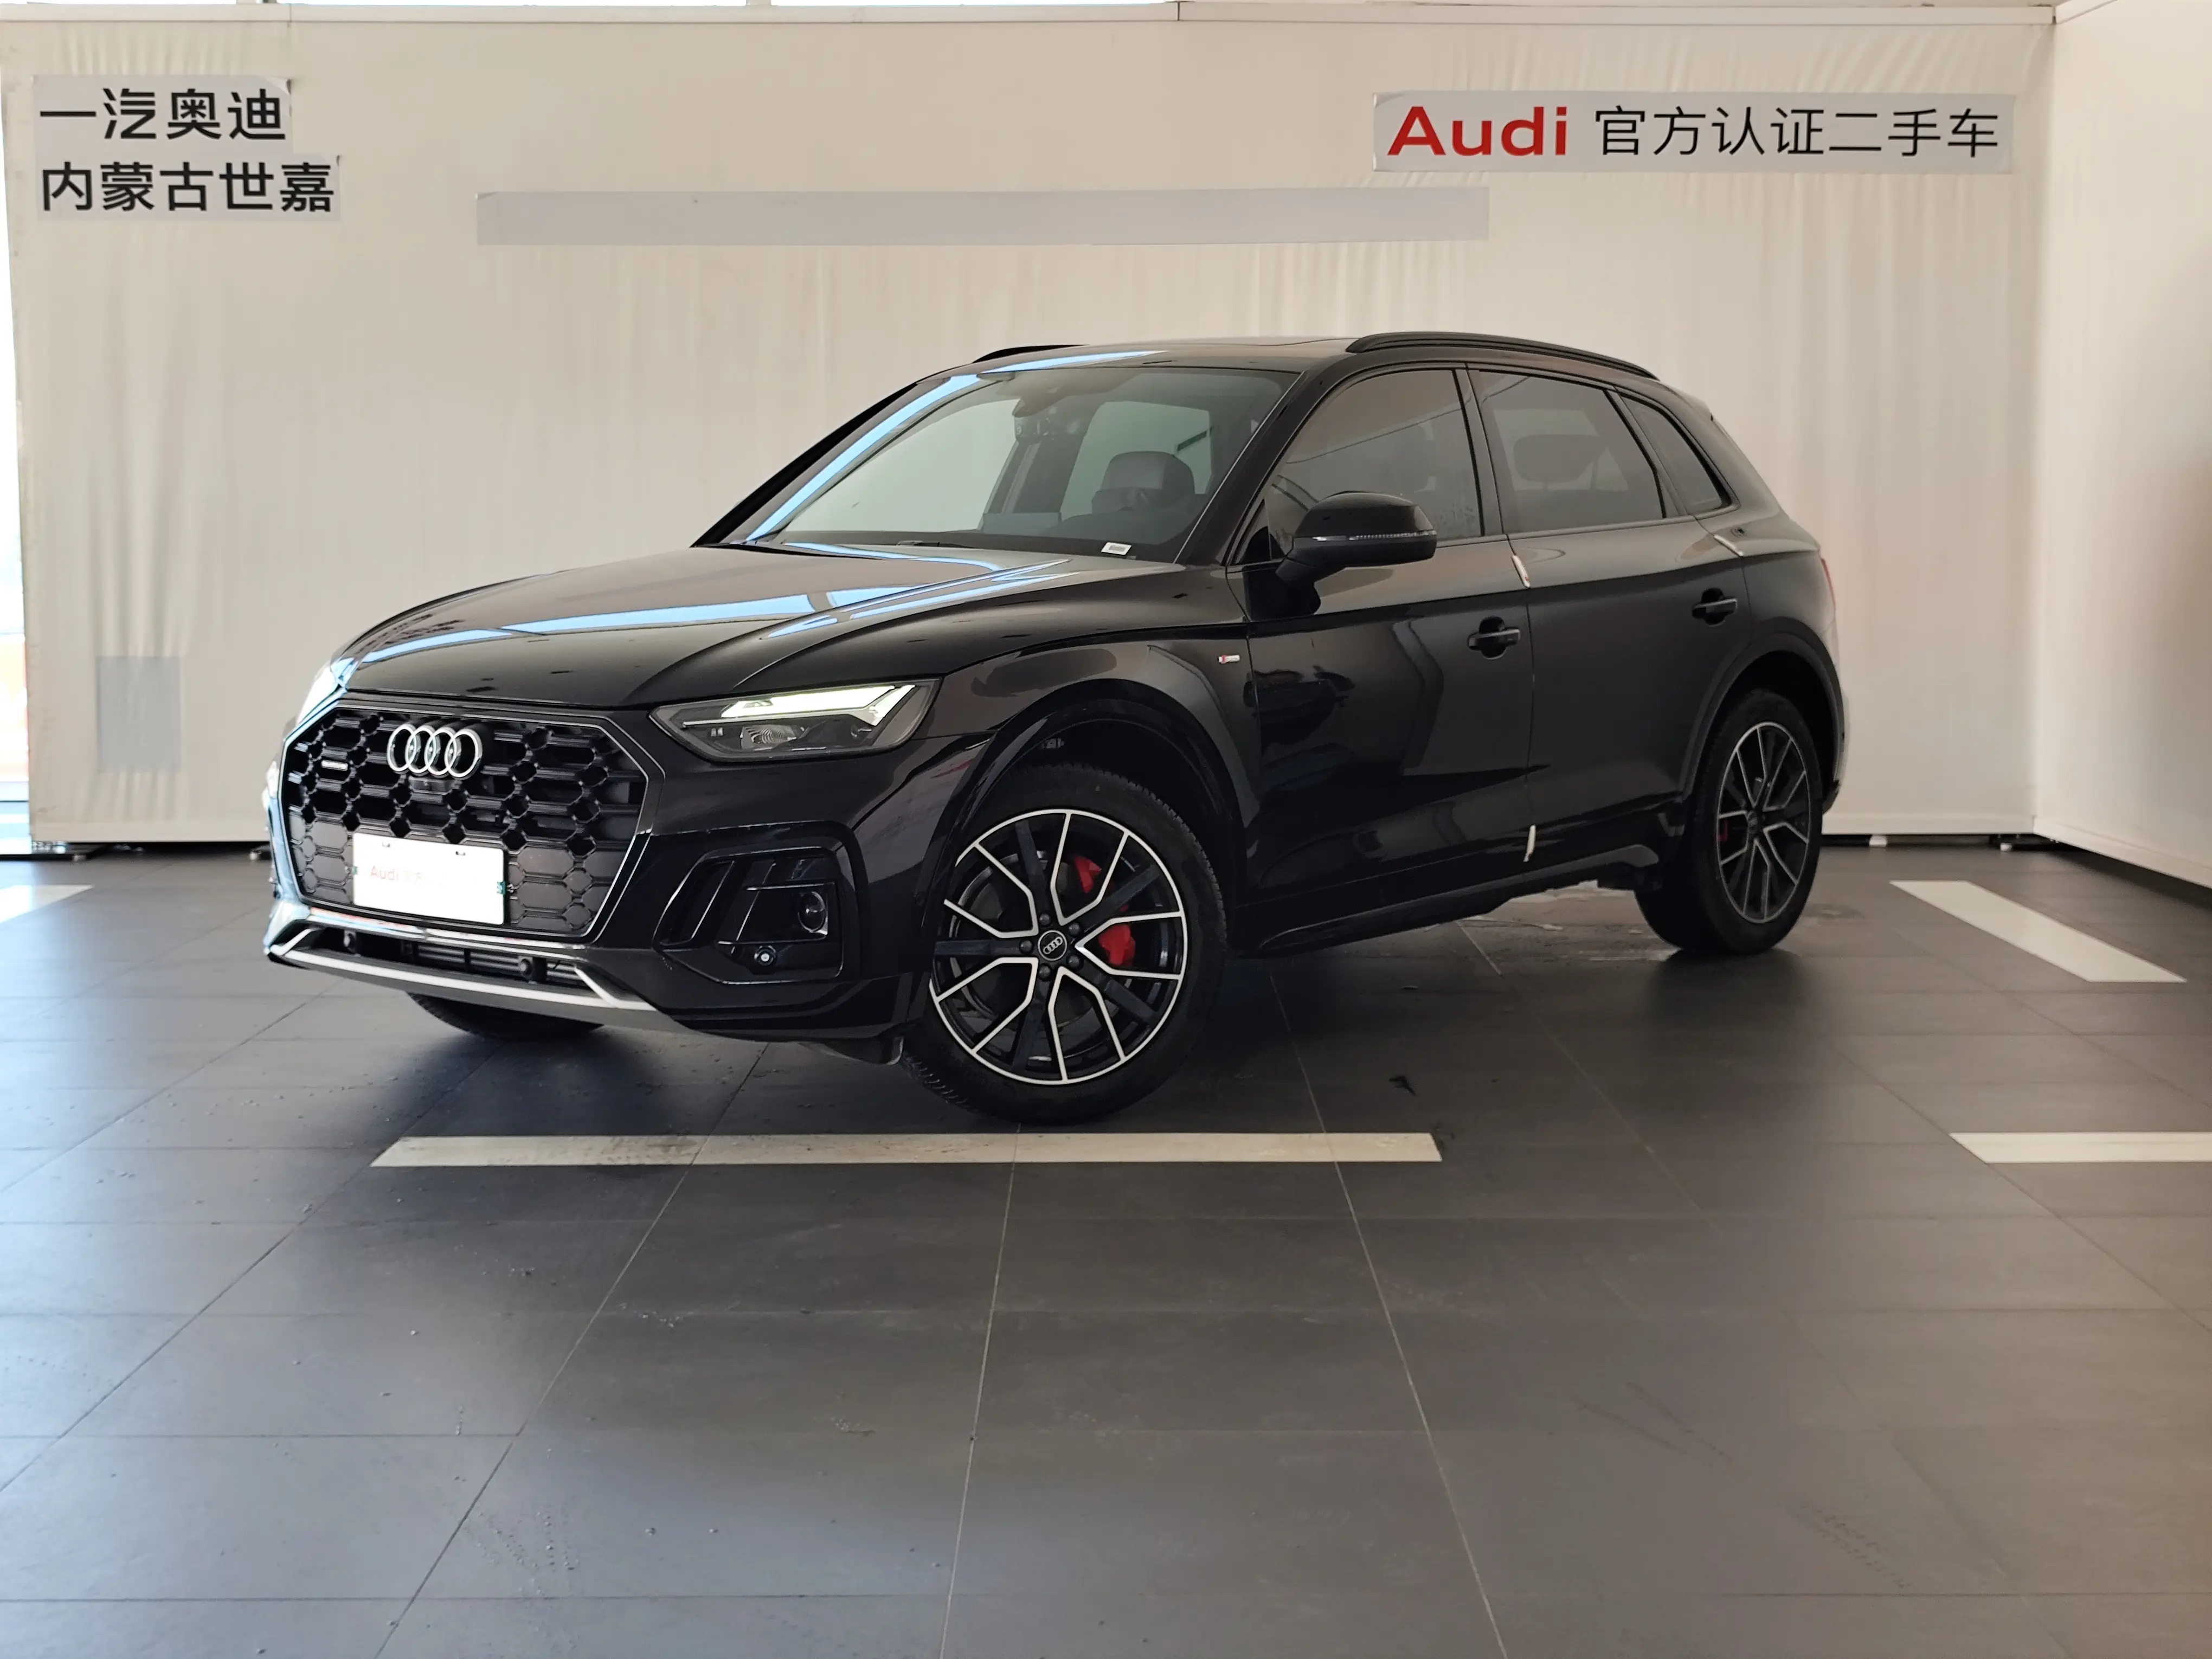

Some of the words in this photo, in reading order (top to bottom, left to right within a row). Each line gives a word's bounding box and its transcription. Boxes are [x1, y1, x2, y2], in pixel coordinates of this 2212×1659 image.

[40, 88, 286, 140] 一汽奥迪
[1387, 106, 1567, 157] Audi
[1595, 105, 1998, 158] 官方认证二手车
[42, 161, 335, 212] 内蒙古世嘉
[370, 865, 399, 882] Audi
